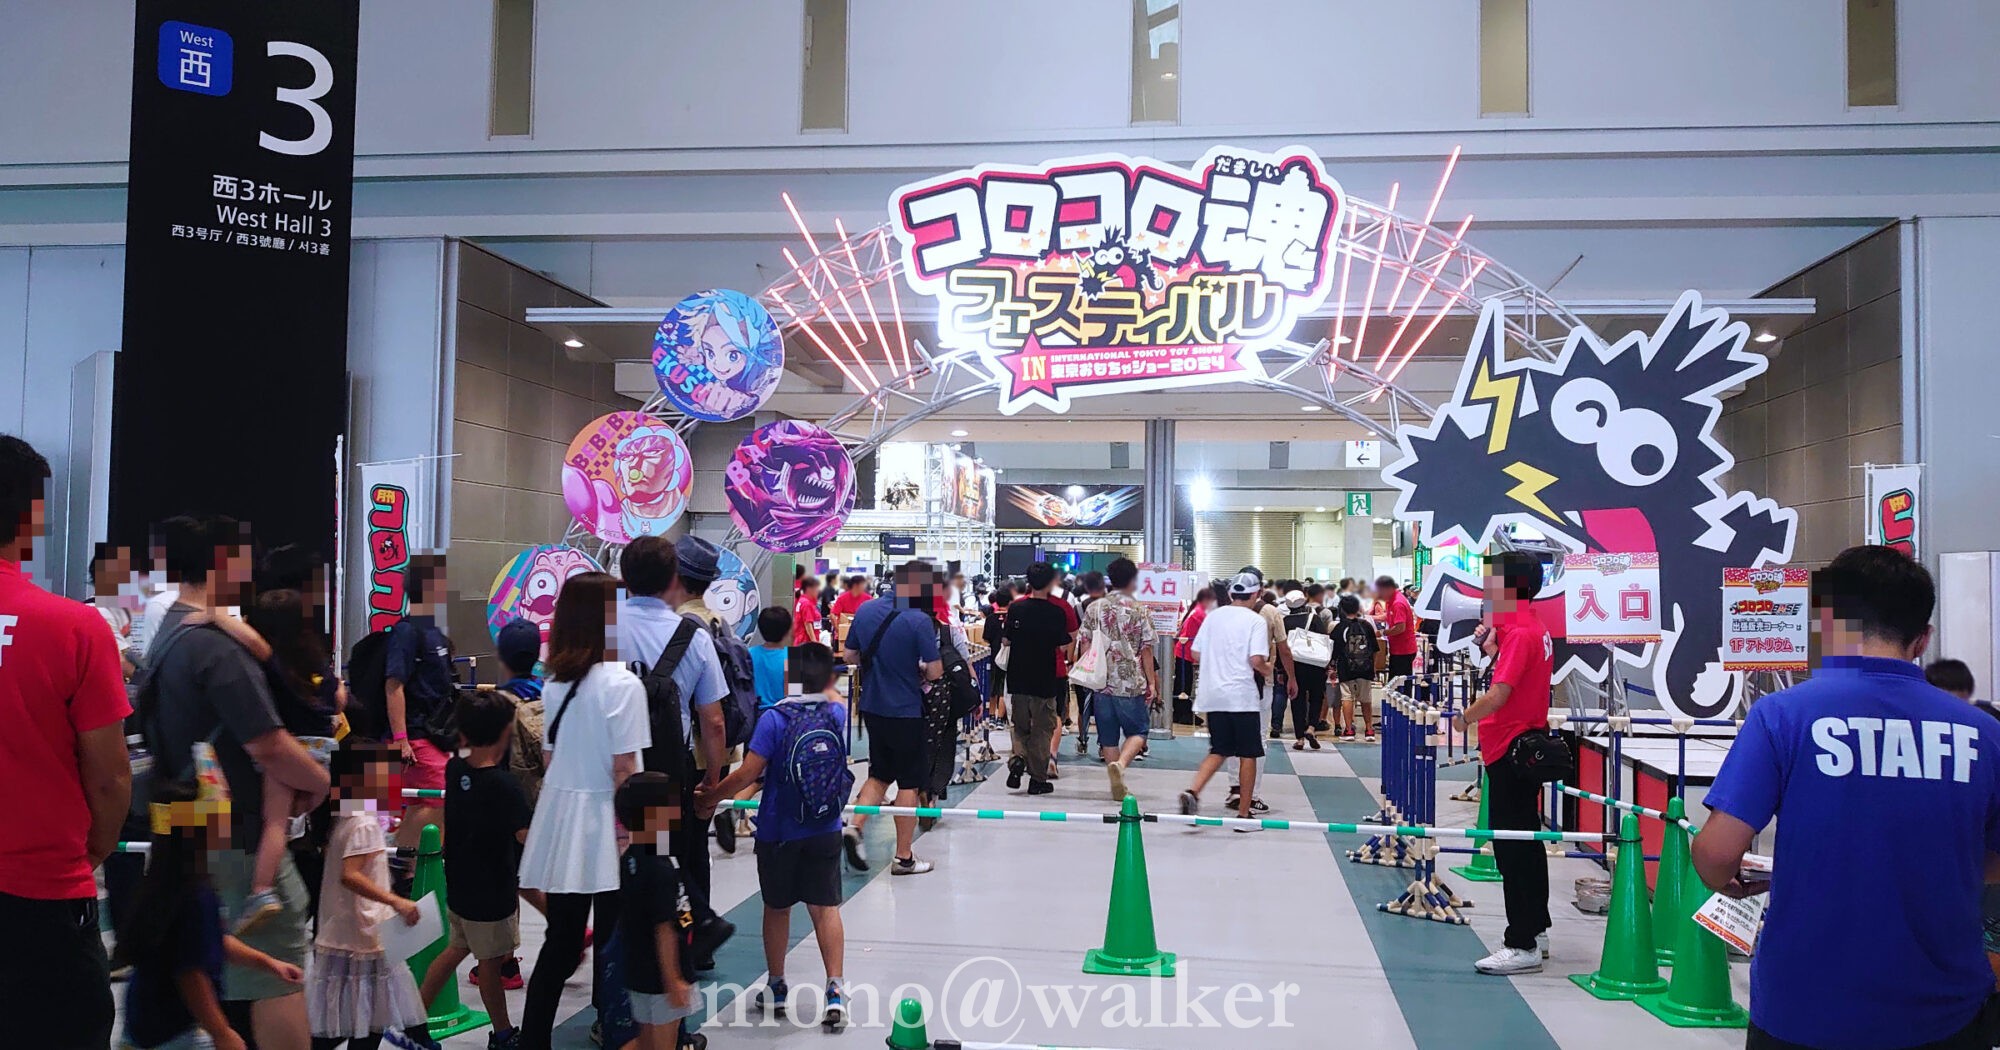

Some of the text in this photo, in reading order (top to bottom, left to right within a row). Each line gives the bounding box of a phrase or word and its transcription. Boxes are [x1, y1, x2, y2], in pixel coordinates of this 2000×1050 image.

[179, 30, 214, 48] West
[180, 48, 212, 87] 西
[259, 41, 334, 156] 3
[1214, 155, 1280, 179] だましい
[213, 174, 332, 211] 西3ホール
[171, 224, 223, 242] 西3号厅
[216, 204, 332, 237] West Hall 3
[906, 164, 1331, 291] コロコロ魂
[950, 272, 1285, 345] フェスティバル
[1021, 355, 1046, 382] IN
[1051, 345, 1224, 362] INTERNATIONAL TOKYO TOY SHOW
[1051, 355, 1225, 379] 東京おもちゃショー2024
[1141, 578, 1177, 596] 入口
[1573, 589, 1652, 622] 入口
[1811, 716, 1979, 783] STAFF
